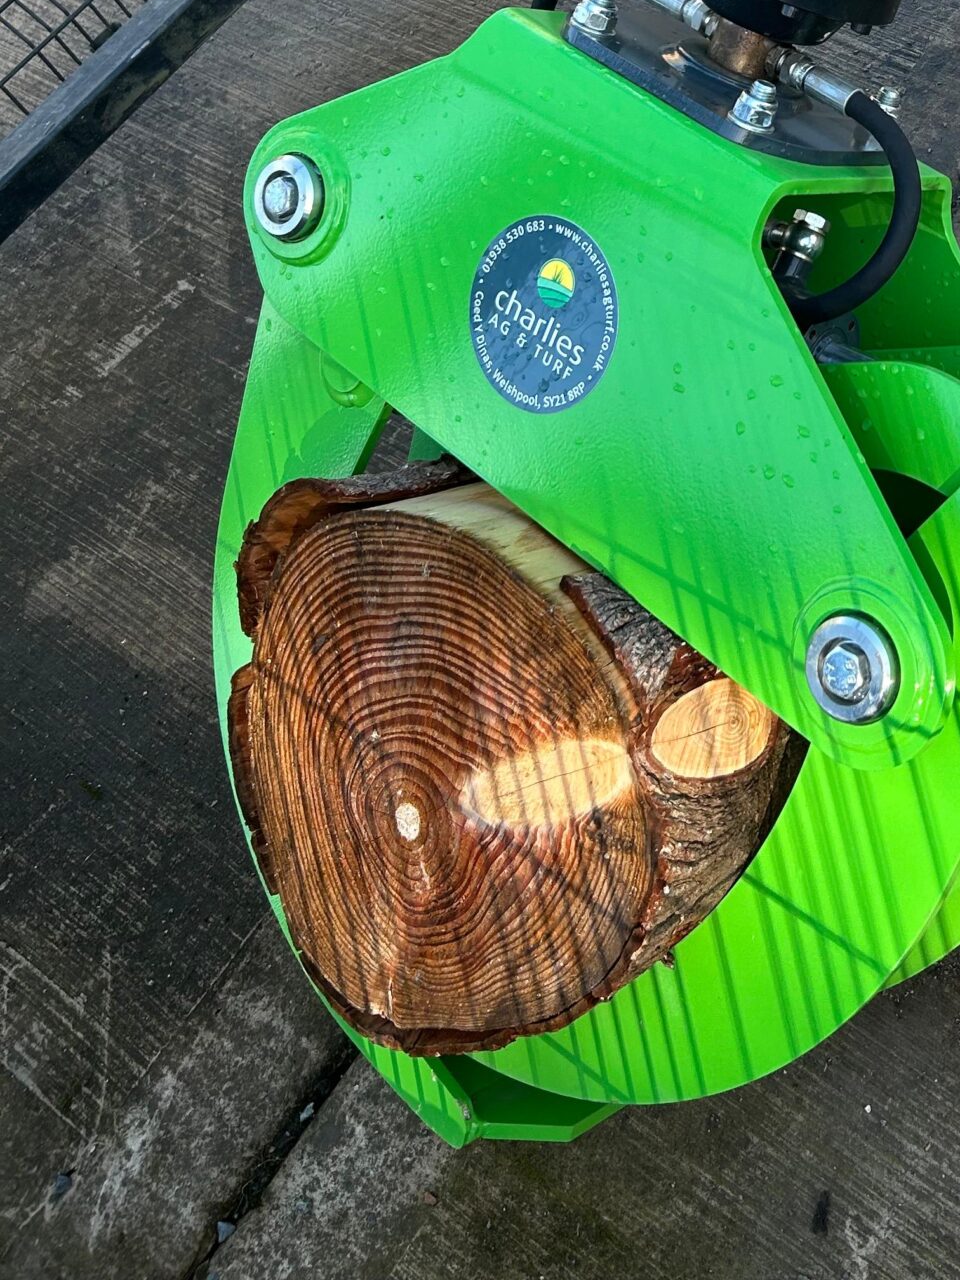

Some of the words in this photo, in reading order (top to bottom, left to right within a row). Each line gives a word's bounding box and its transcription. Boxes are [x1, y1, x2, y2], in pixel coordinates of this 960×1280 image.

[482, 239, 506, 273] 01938
[506, 225, 525, 243] 530
[526, 220, 545, 233] 683
[495, 290, 585, 365] charlies
[555, 223, 615, 372] www.charliesagturf.co.uk
[474, 324, 484, 332] Y
[492, 368, 541, 409] Welshpool,
[543, 394, 567, 408] SY21
[567, 381, 585, 401] 8RP
[488, 313, 511, 335] AG
[516, 333, 528, 347] &
[534, 344, 573, 379] TURF
